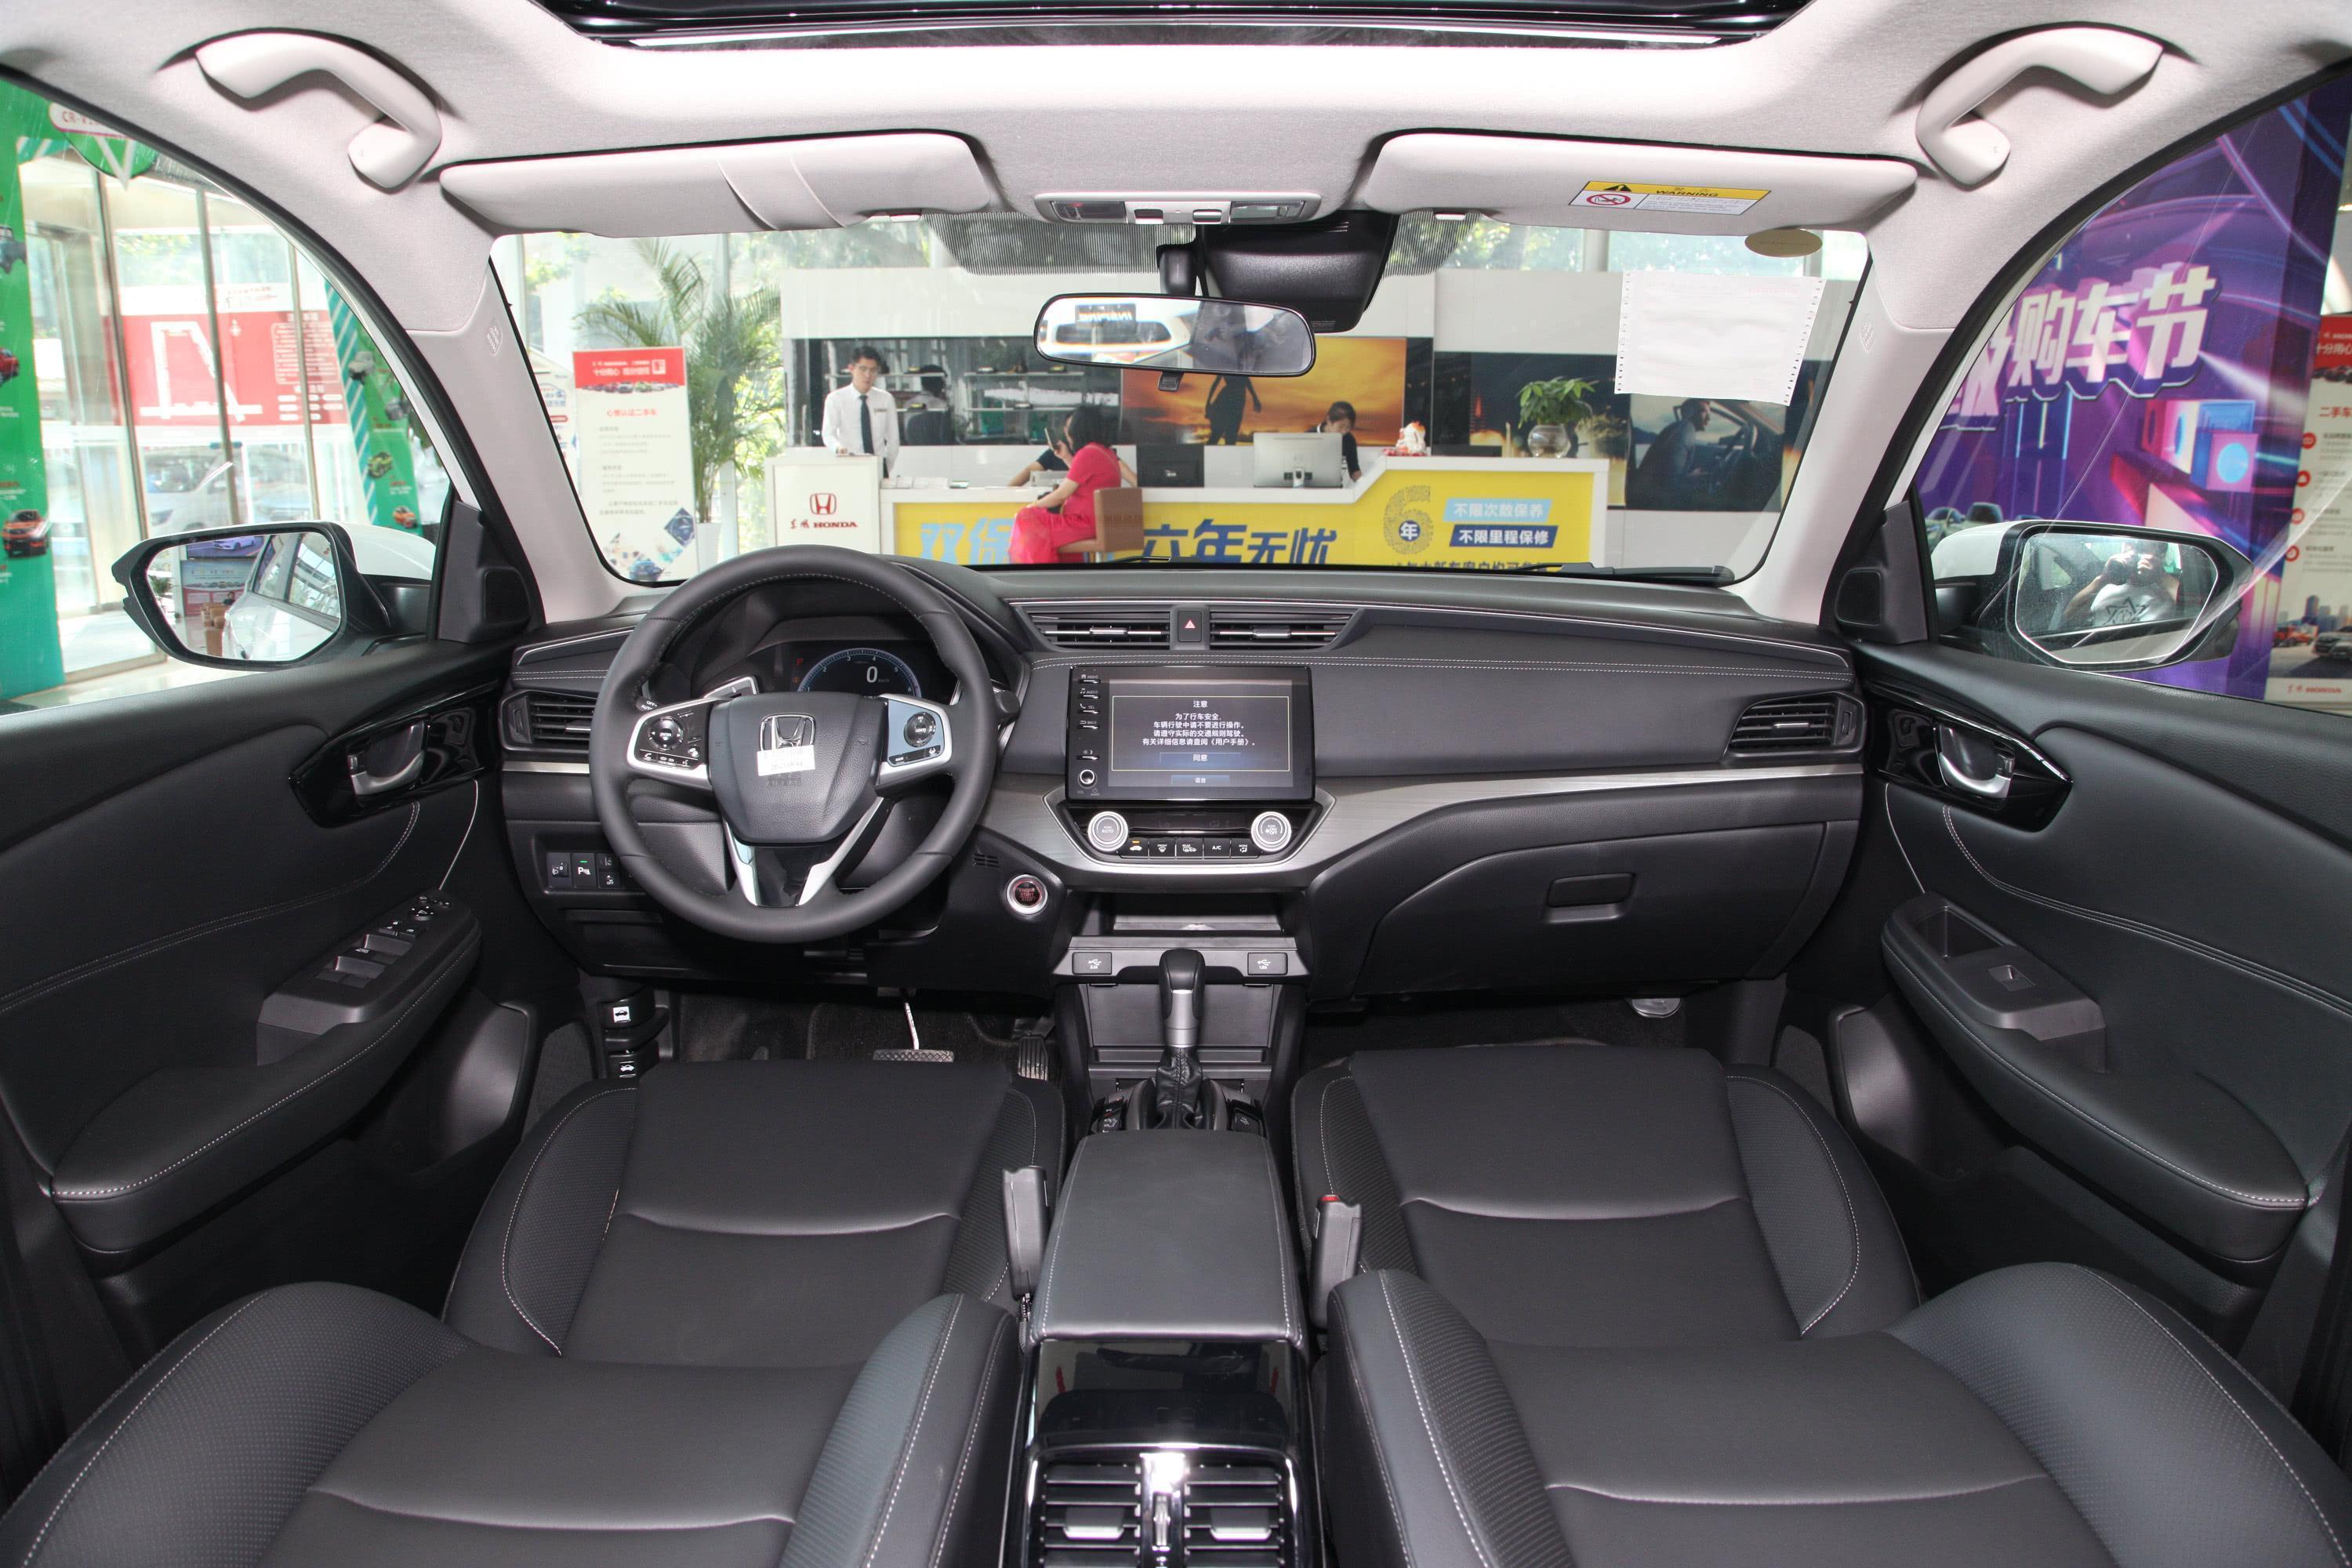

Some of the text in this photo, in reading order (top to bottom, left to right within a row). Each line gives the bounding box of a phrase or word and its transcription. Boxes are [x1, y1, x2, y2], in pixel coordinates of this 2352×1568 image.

[1454, 503, 1544, 518] 不限次数保养
[1400, 523, 1418, 540] 年
[1458, 529, 1549, 545] 不限里程保修
[866, 666, 878, 684] 0
